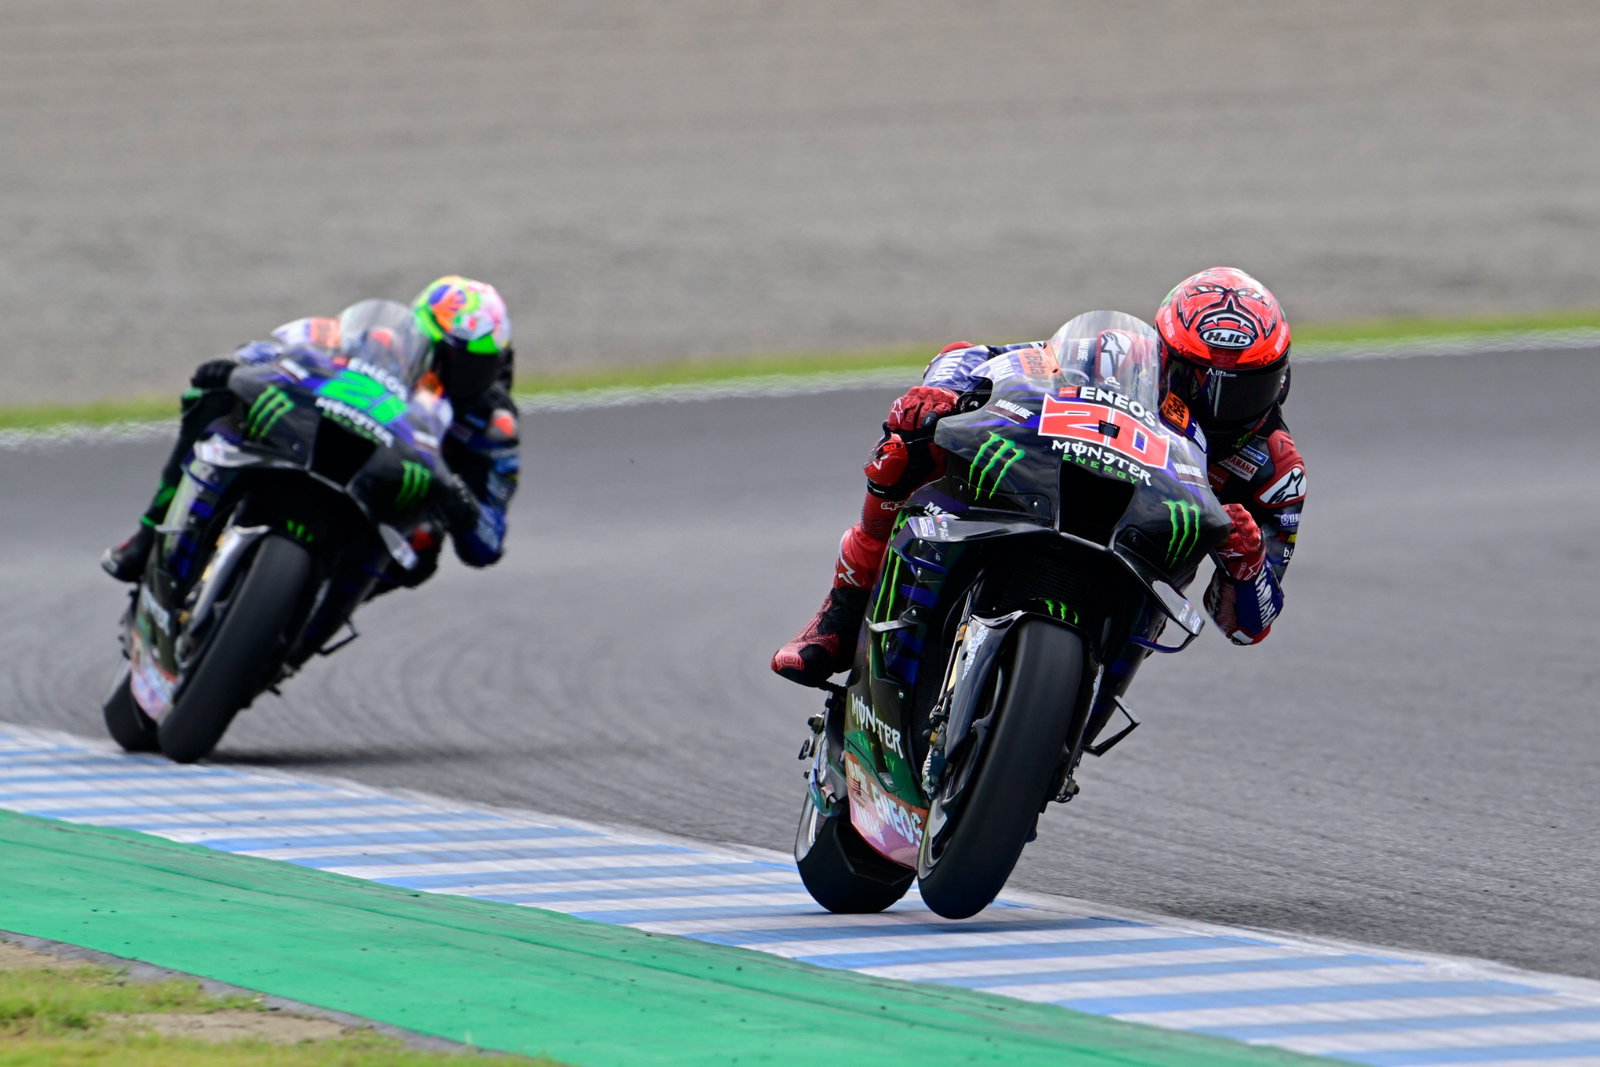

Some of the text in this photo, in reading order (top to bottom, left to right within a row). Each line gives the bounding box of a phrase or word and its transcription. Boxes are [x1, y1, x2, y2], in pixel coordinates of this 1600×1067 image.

[1205, 331, 1249, 346] HJC
[1079, 385, 1157, 428] ENEOS
[1037, 393, 1171, 471] 20
[1062, 453, 1139, 485] ENERGY
[1227, 456, 1258, 474] YAMAHA
[1255, 567, 1278, 631] YAMAHA
[870, 782, 924, 848] ENEOS
